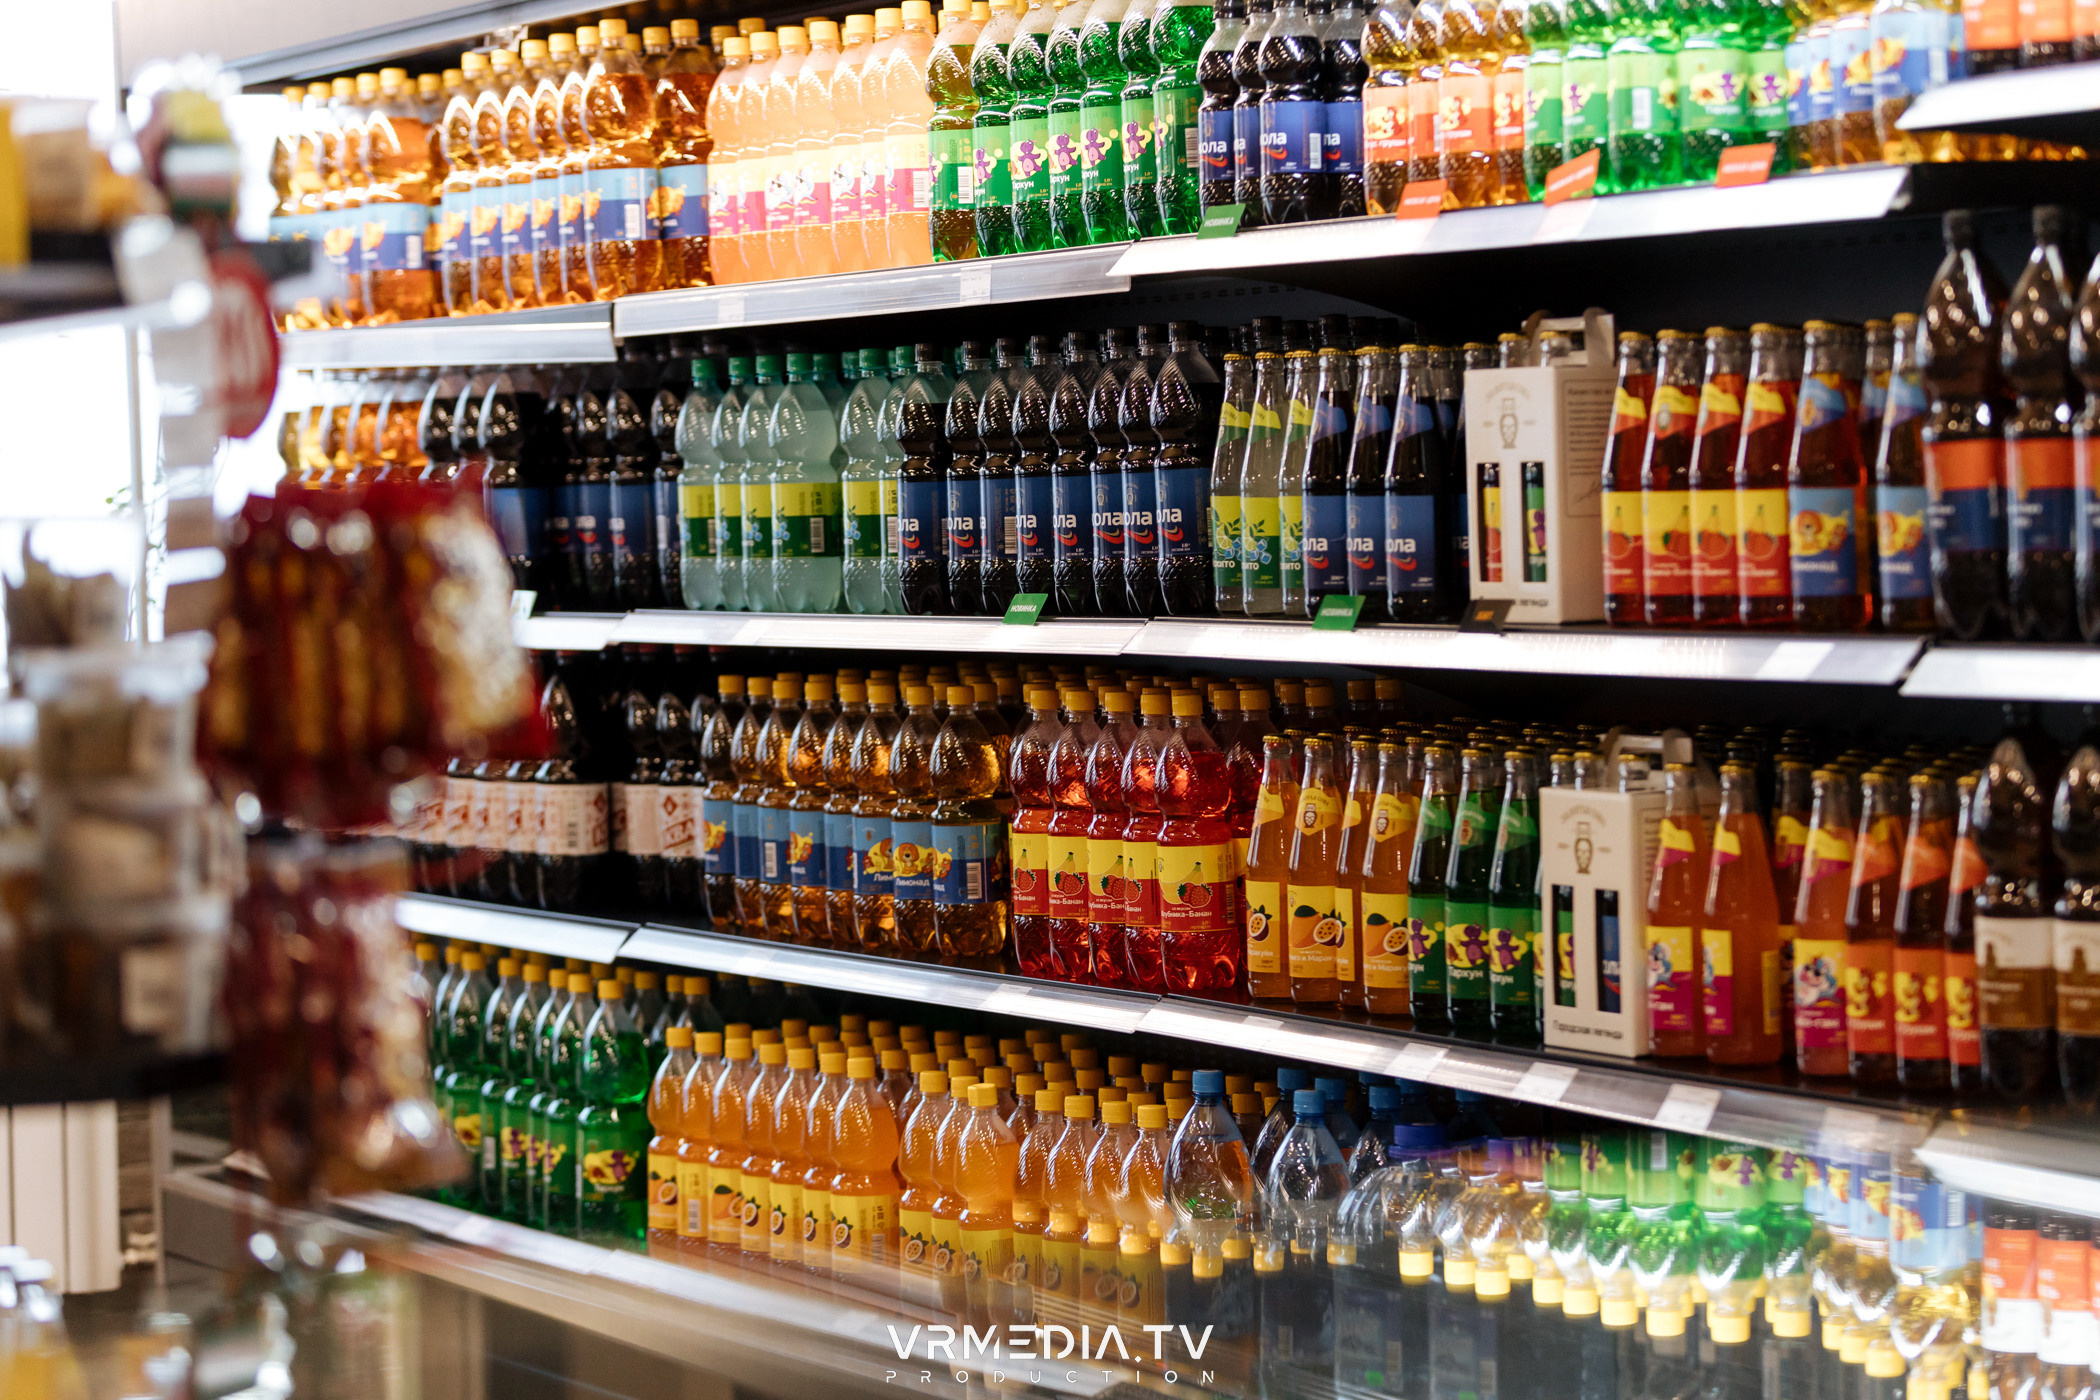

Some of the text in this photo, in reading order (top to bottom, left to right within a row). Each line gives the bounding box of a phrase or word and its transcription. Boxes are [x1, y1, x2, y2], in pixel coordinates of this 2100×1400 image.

[1259, 132, 1287, 146] ола
[947, 516, 974, 531] ола
[1053, 514, 1077, 528] ола
[1123, 511, 1152, 526] ола
[1156, 508, 1182, 524] ола
[1303, 537, 1328, 552] ола
[1346, 537, 1374, 552] ола
[1385, 538, 1416, 553] ола
